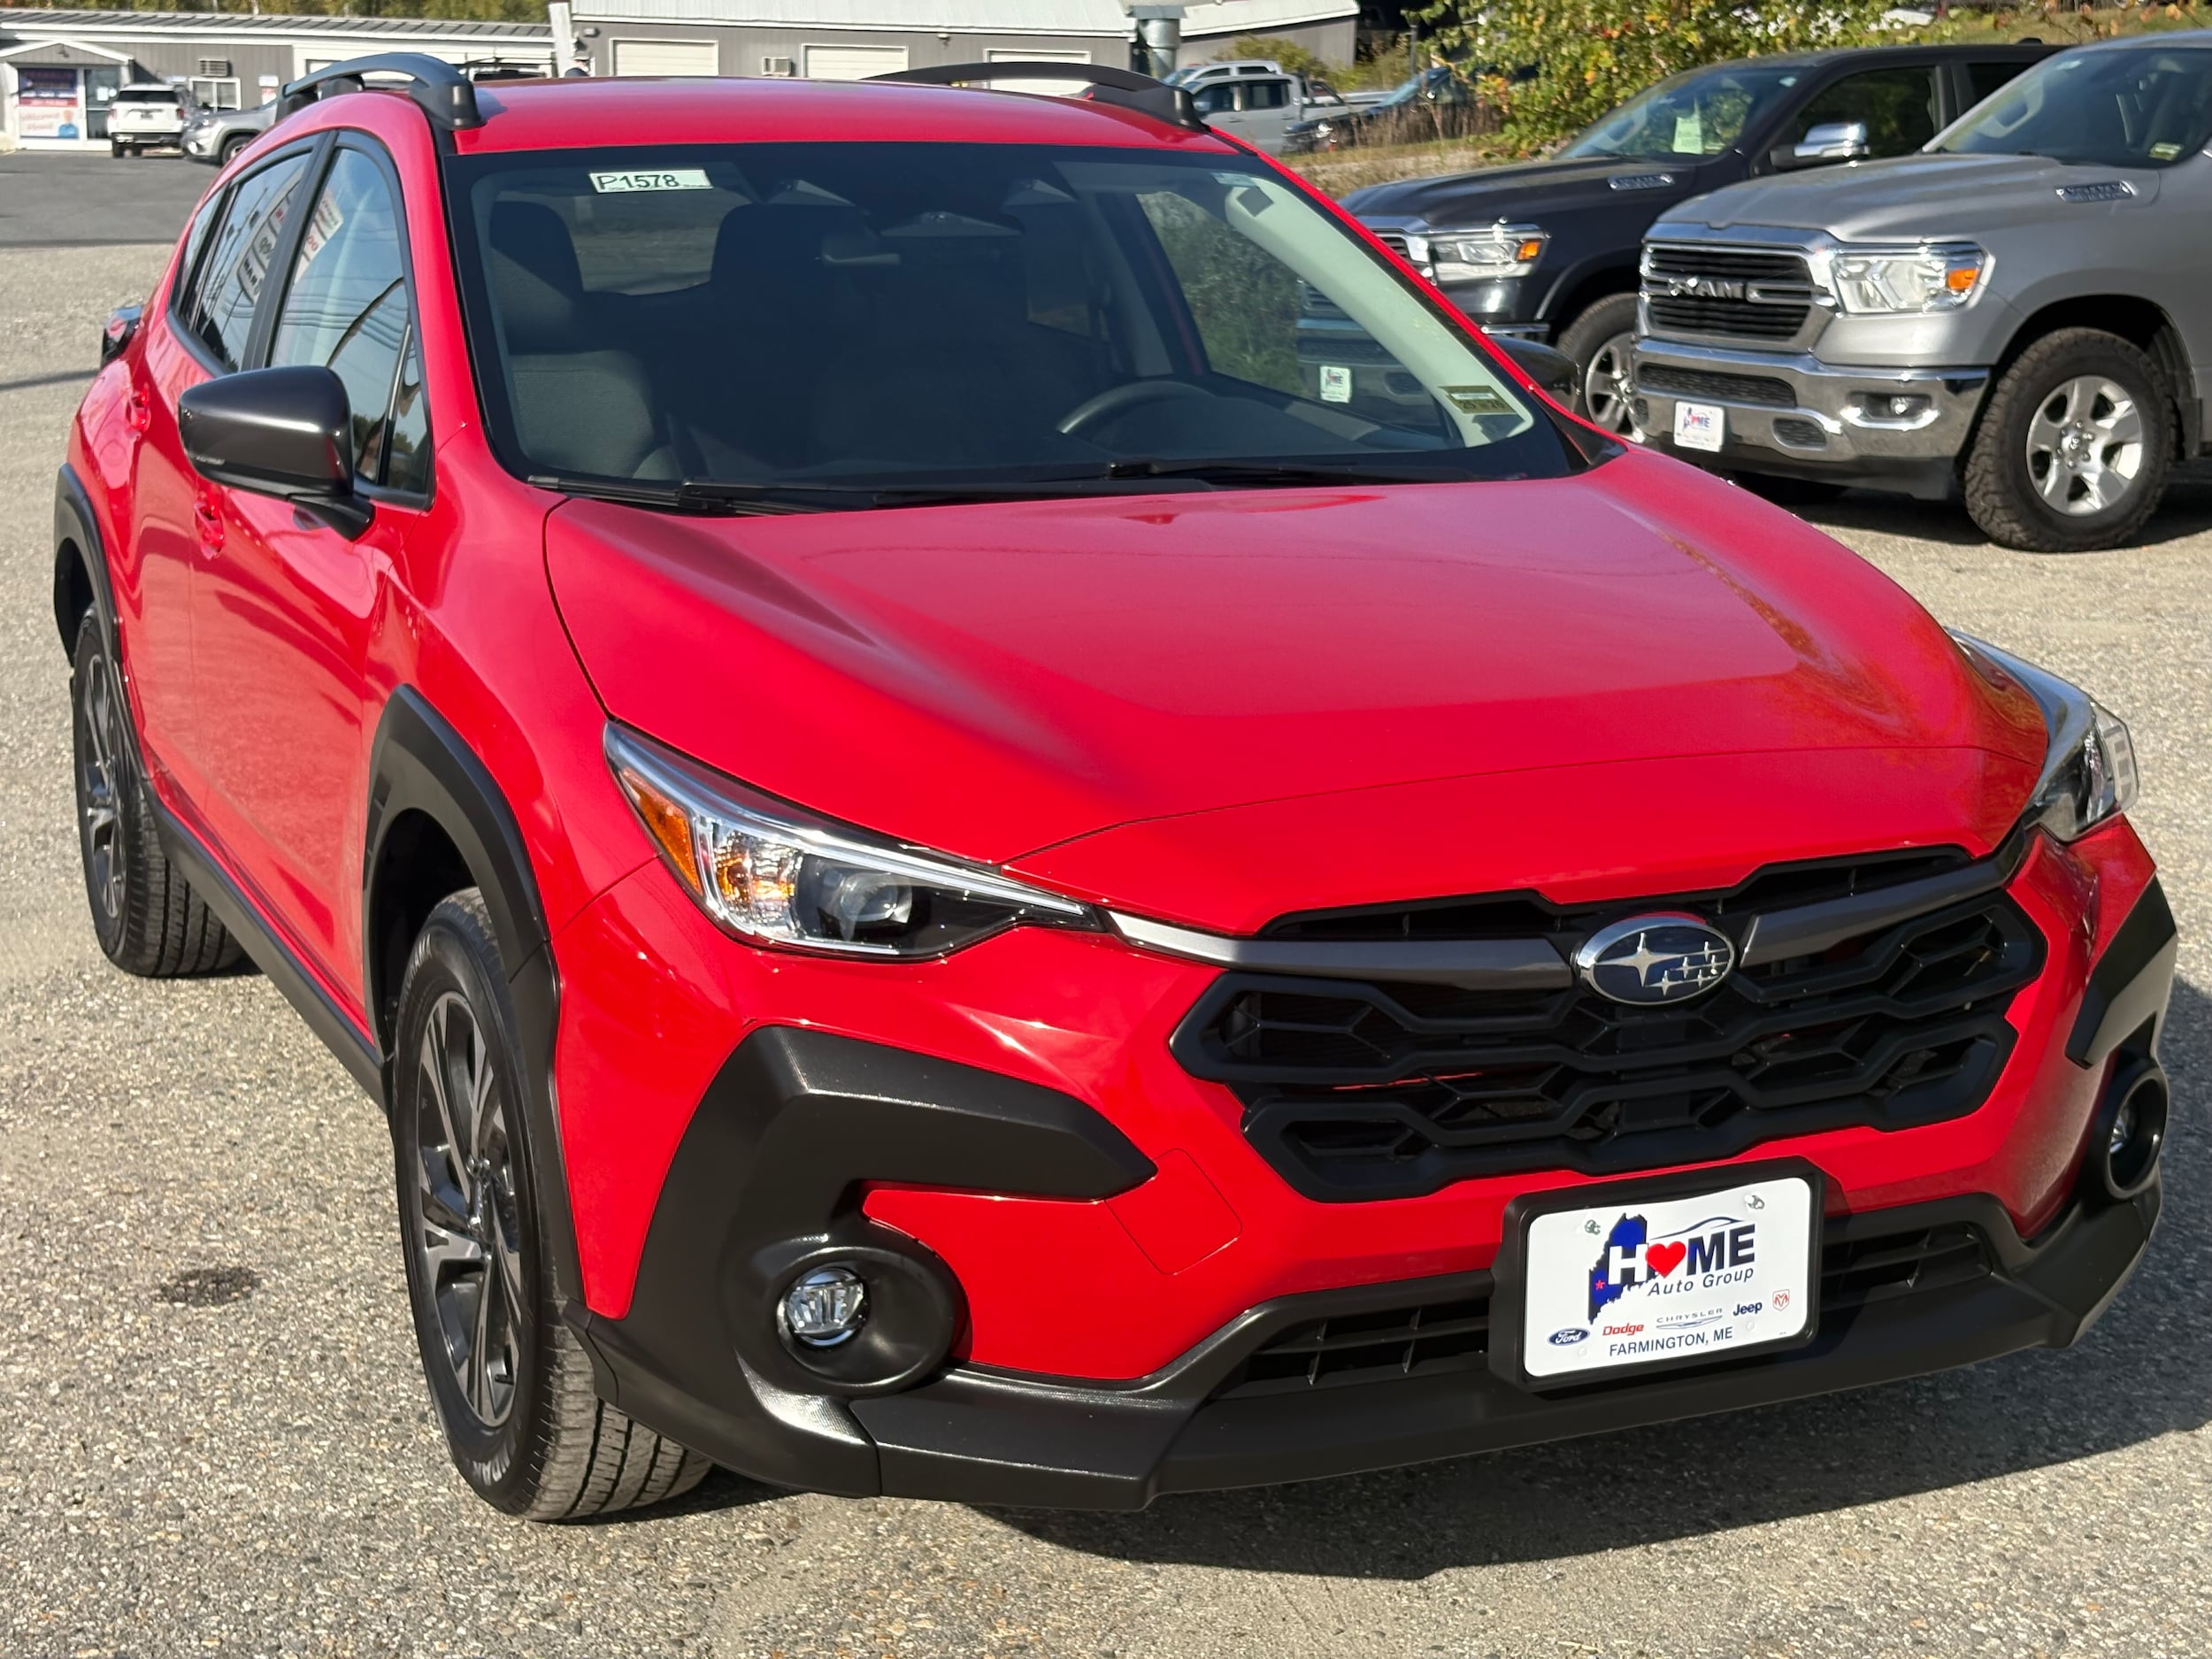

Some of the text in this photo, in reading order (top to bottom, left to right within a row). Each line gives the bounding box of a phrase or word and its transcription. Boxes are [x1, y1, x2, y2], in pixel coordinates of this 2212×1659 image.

[596, 174, 680, 189] P1578
[1678, 277, 1744, 299] RAM
[1647, 1268, 1754, 1296] Auto Group
[1656, 1308, 1723, 1323] CHRYSLER
[1732, 1302, 1763, 1317] Jeep
[1602, 1323, 1644, 1336] Dodge
[1609, 1326, 1733, 1356] FARMINGTON, ME
